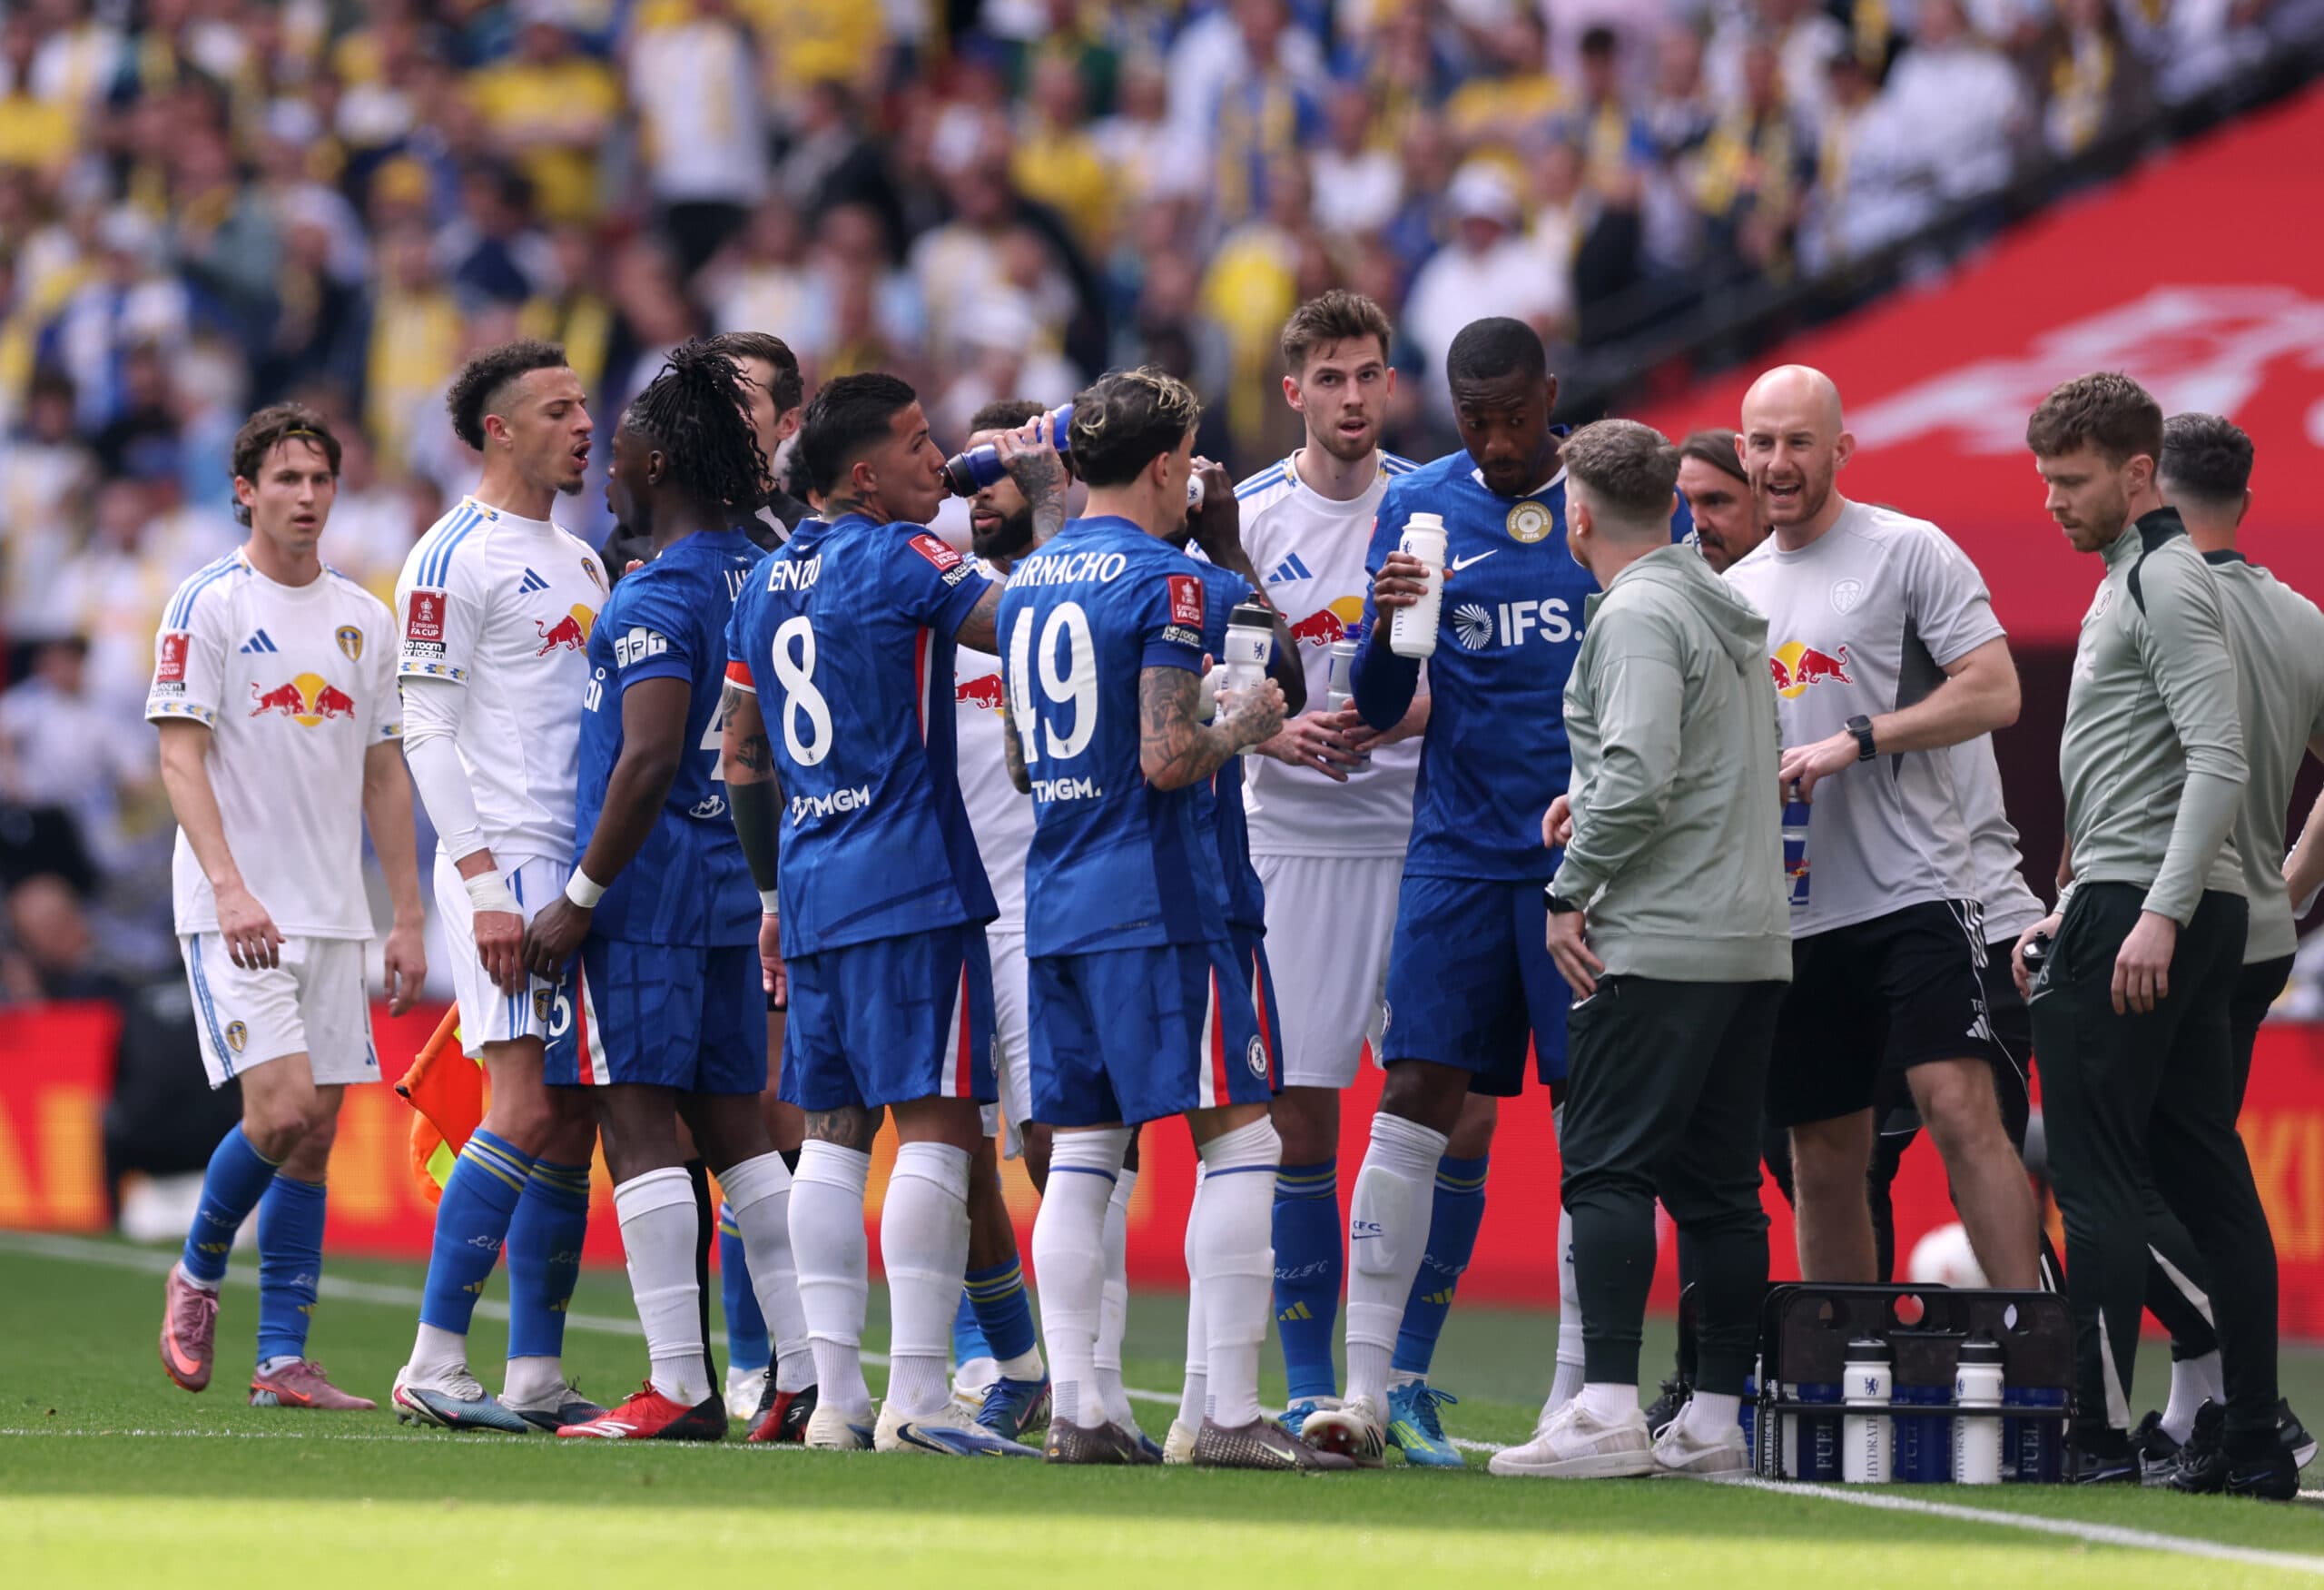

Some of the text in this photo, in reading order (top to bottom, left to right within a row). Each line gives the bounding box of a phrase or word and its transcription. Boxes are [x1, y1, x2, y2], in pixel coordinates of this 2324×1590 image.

[768, 554, 822, 592] ENZO
[415, 641, 442, 652] room
[1499, 597, 1583, 647] IFS.
[616, 633, 665, 663] FPT
[772, 616, 833, 766] 8
[1009, 601, 1098, 765] 49
[1353, 1220, 1383, 1232] CFC
[1866, 1415, 1878, 1477] HYDRATE
[2023, 1423, 2039, 1473] FUEL
